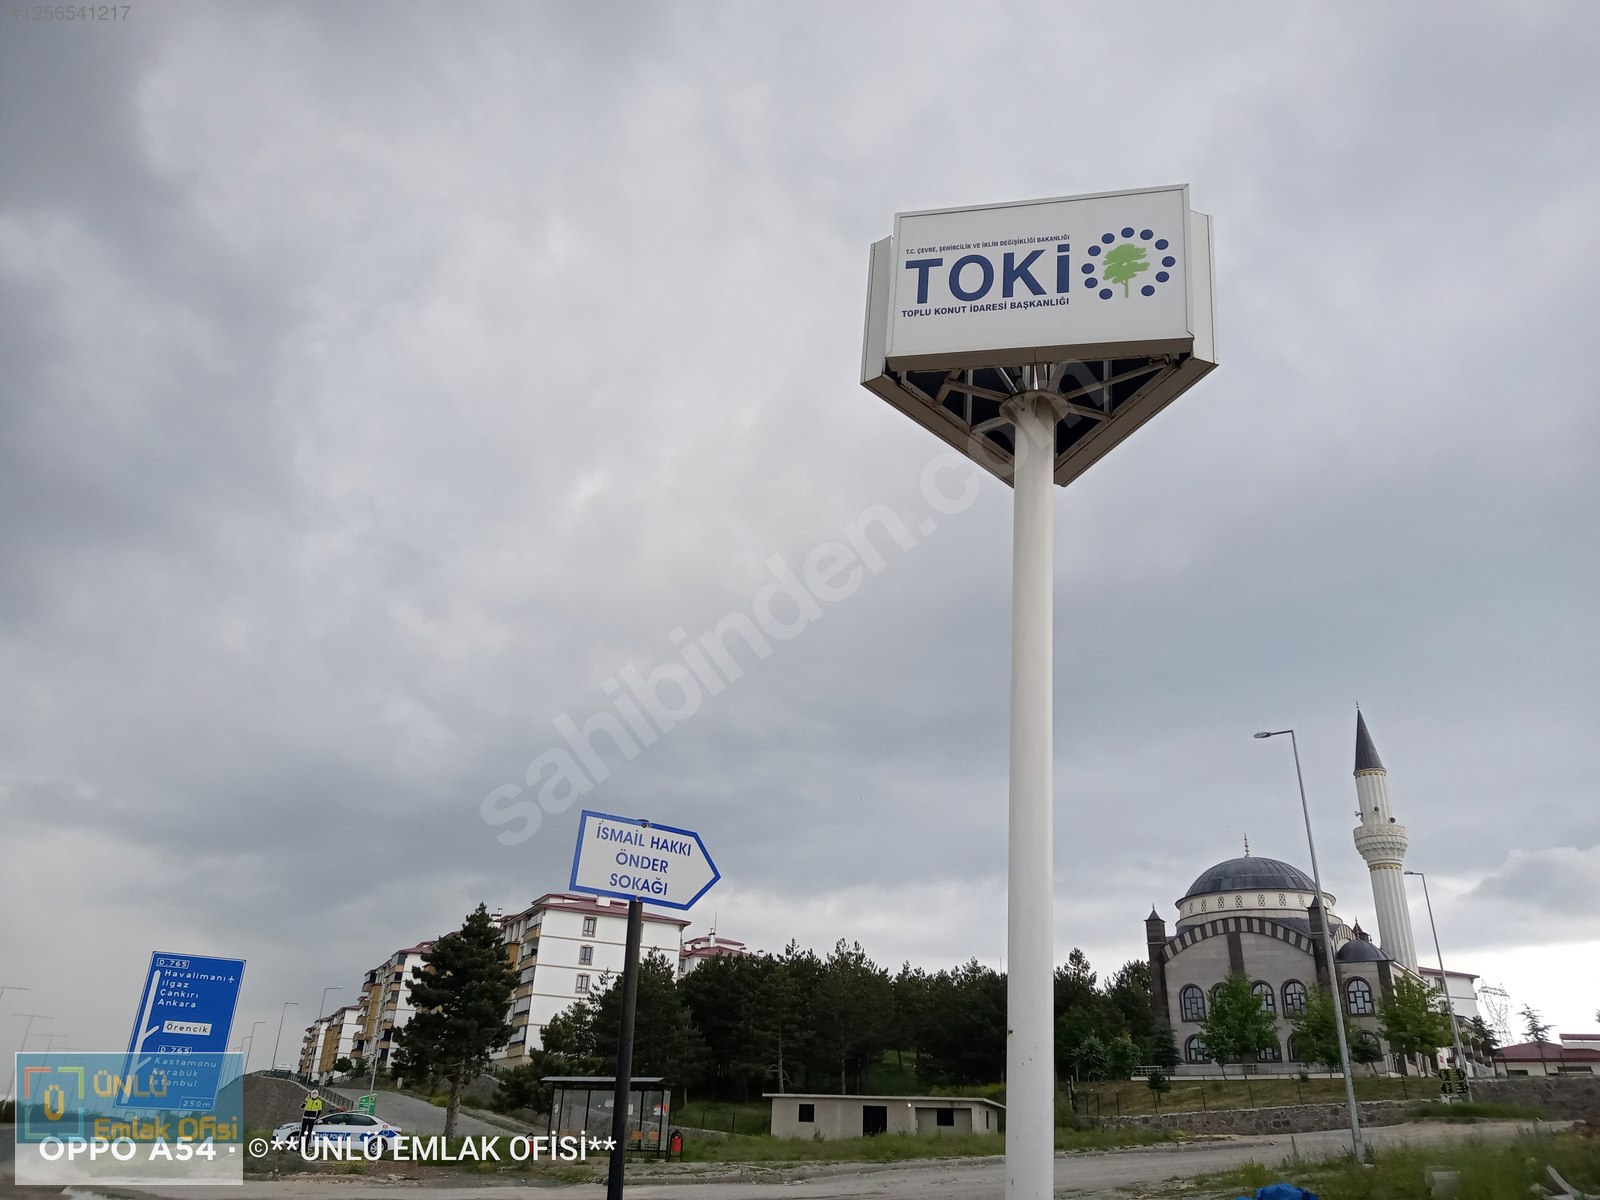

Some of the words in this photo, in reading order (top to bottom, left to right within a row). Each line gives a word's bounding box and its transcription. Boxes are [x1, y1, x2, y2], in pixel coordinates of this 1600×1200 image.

[939, 243, 971, 252] ŞEHİRCİLİK
[1000, 238, 1036, 246] DEĞİŞİKLİĞİ
[1037, 234, 1070, 242] BAKANLIĞI
[902, 308, 932, 317] TOPLU
[934, 305, 968, 315] KONUT
[969, 300, 1007, 313] İDARESİ
[1010, 296, 1070, 310] BAŞKANLIĞI
[596, 822, 646, 847] İSMAİL
[650, 835, 692, 857] HAKKI
[615, 848, 669, 874] ÖNDER
[609, 872, 668, 896] SOKAĞI
[164, 969, 227, 982] Havalimanı
[159, 988, 199, 999] Çankırı
[157, 998, 197, 1009] Ankara
[166, 1021, 208, 1033] Örencik
[154, 1056, 217, 1068] Kastamonu
